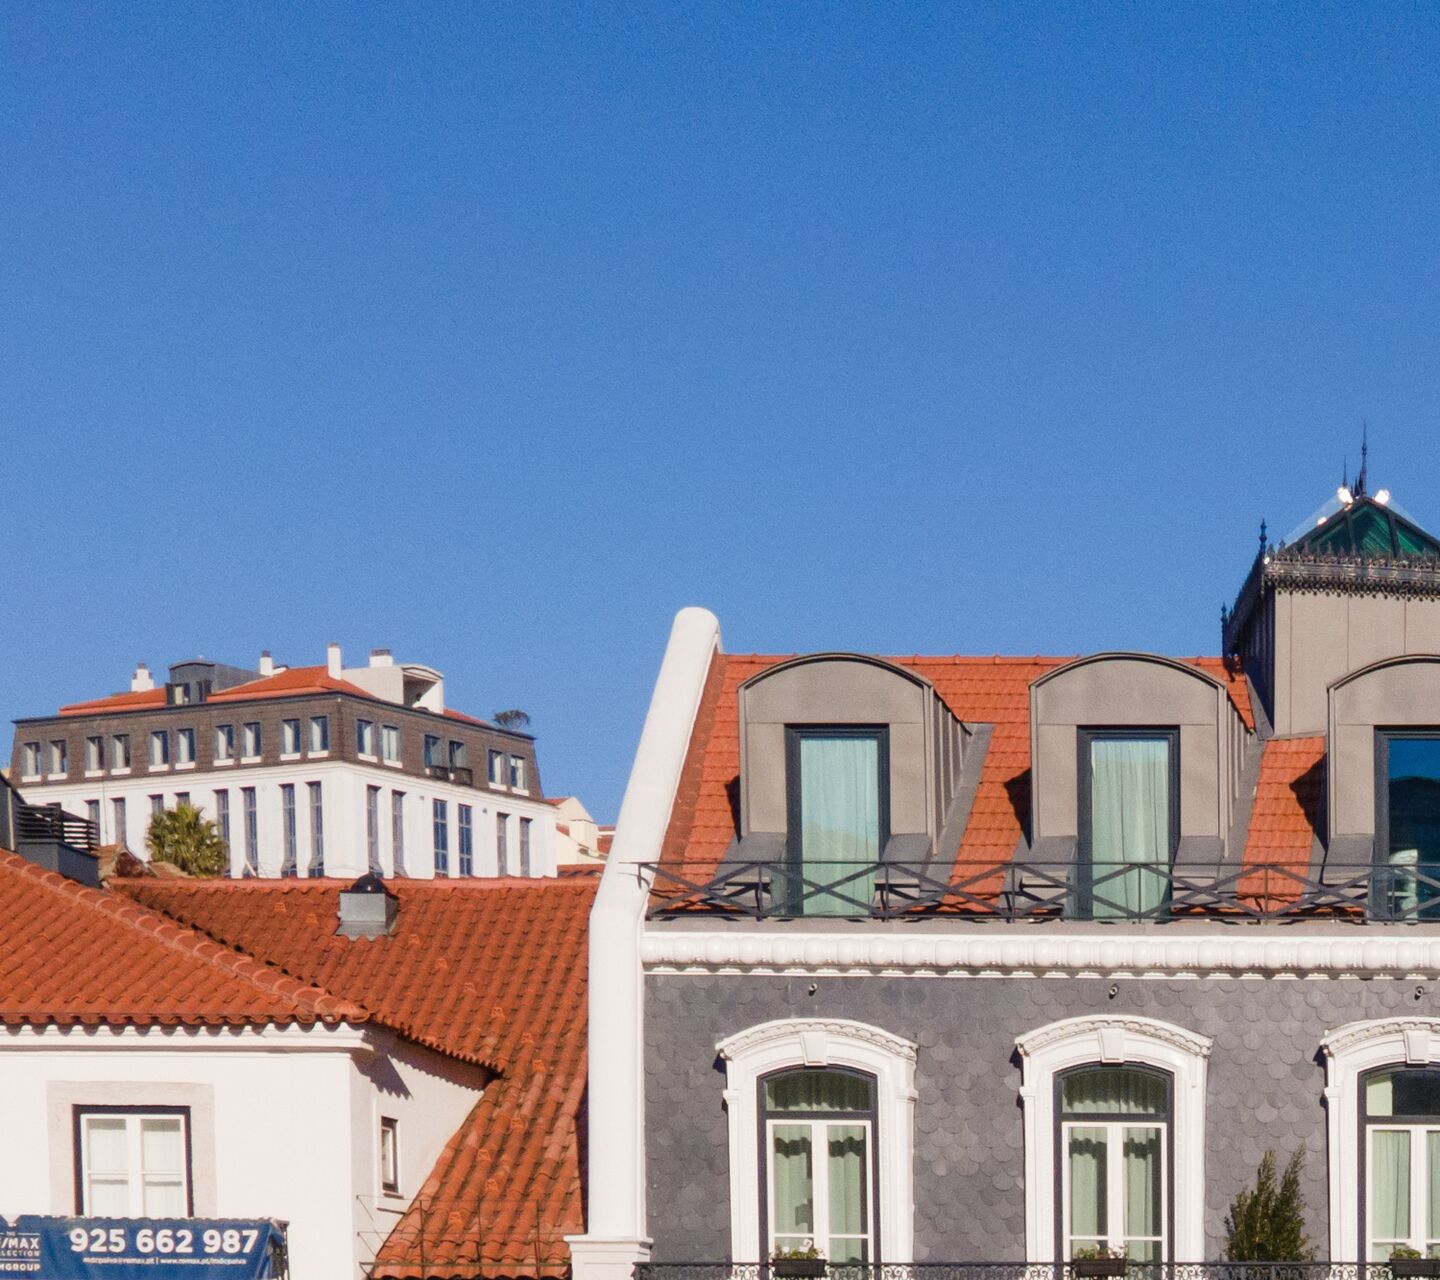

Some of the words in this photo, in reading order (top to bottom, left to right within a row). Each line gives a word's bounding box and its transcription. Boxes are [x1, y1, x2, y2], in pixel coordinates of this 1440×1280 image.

[0, 1237, 39, 1249] /MAX
[69, 1227, 126, 1253] 925
[136, 1228, 193, 1254] 662
[202, 1228, 259, 1254] 987
[0, 1249, 40, 1257] LECTION
